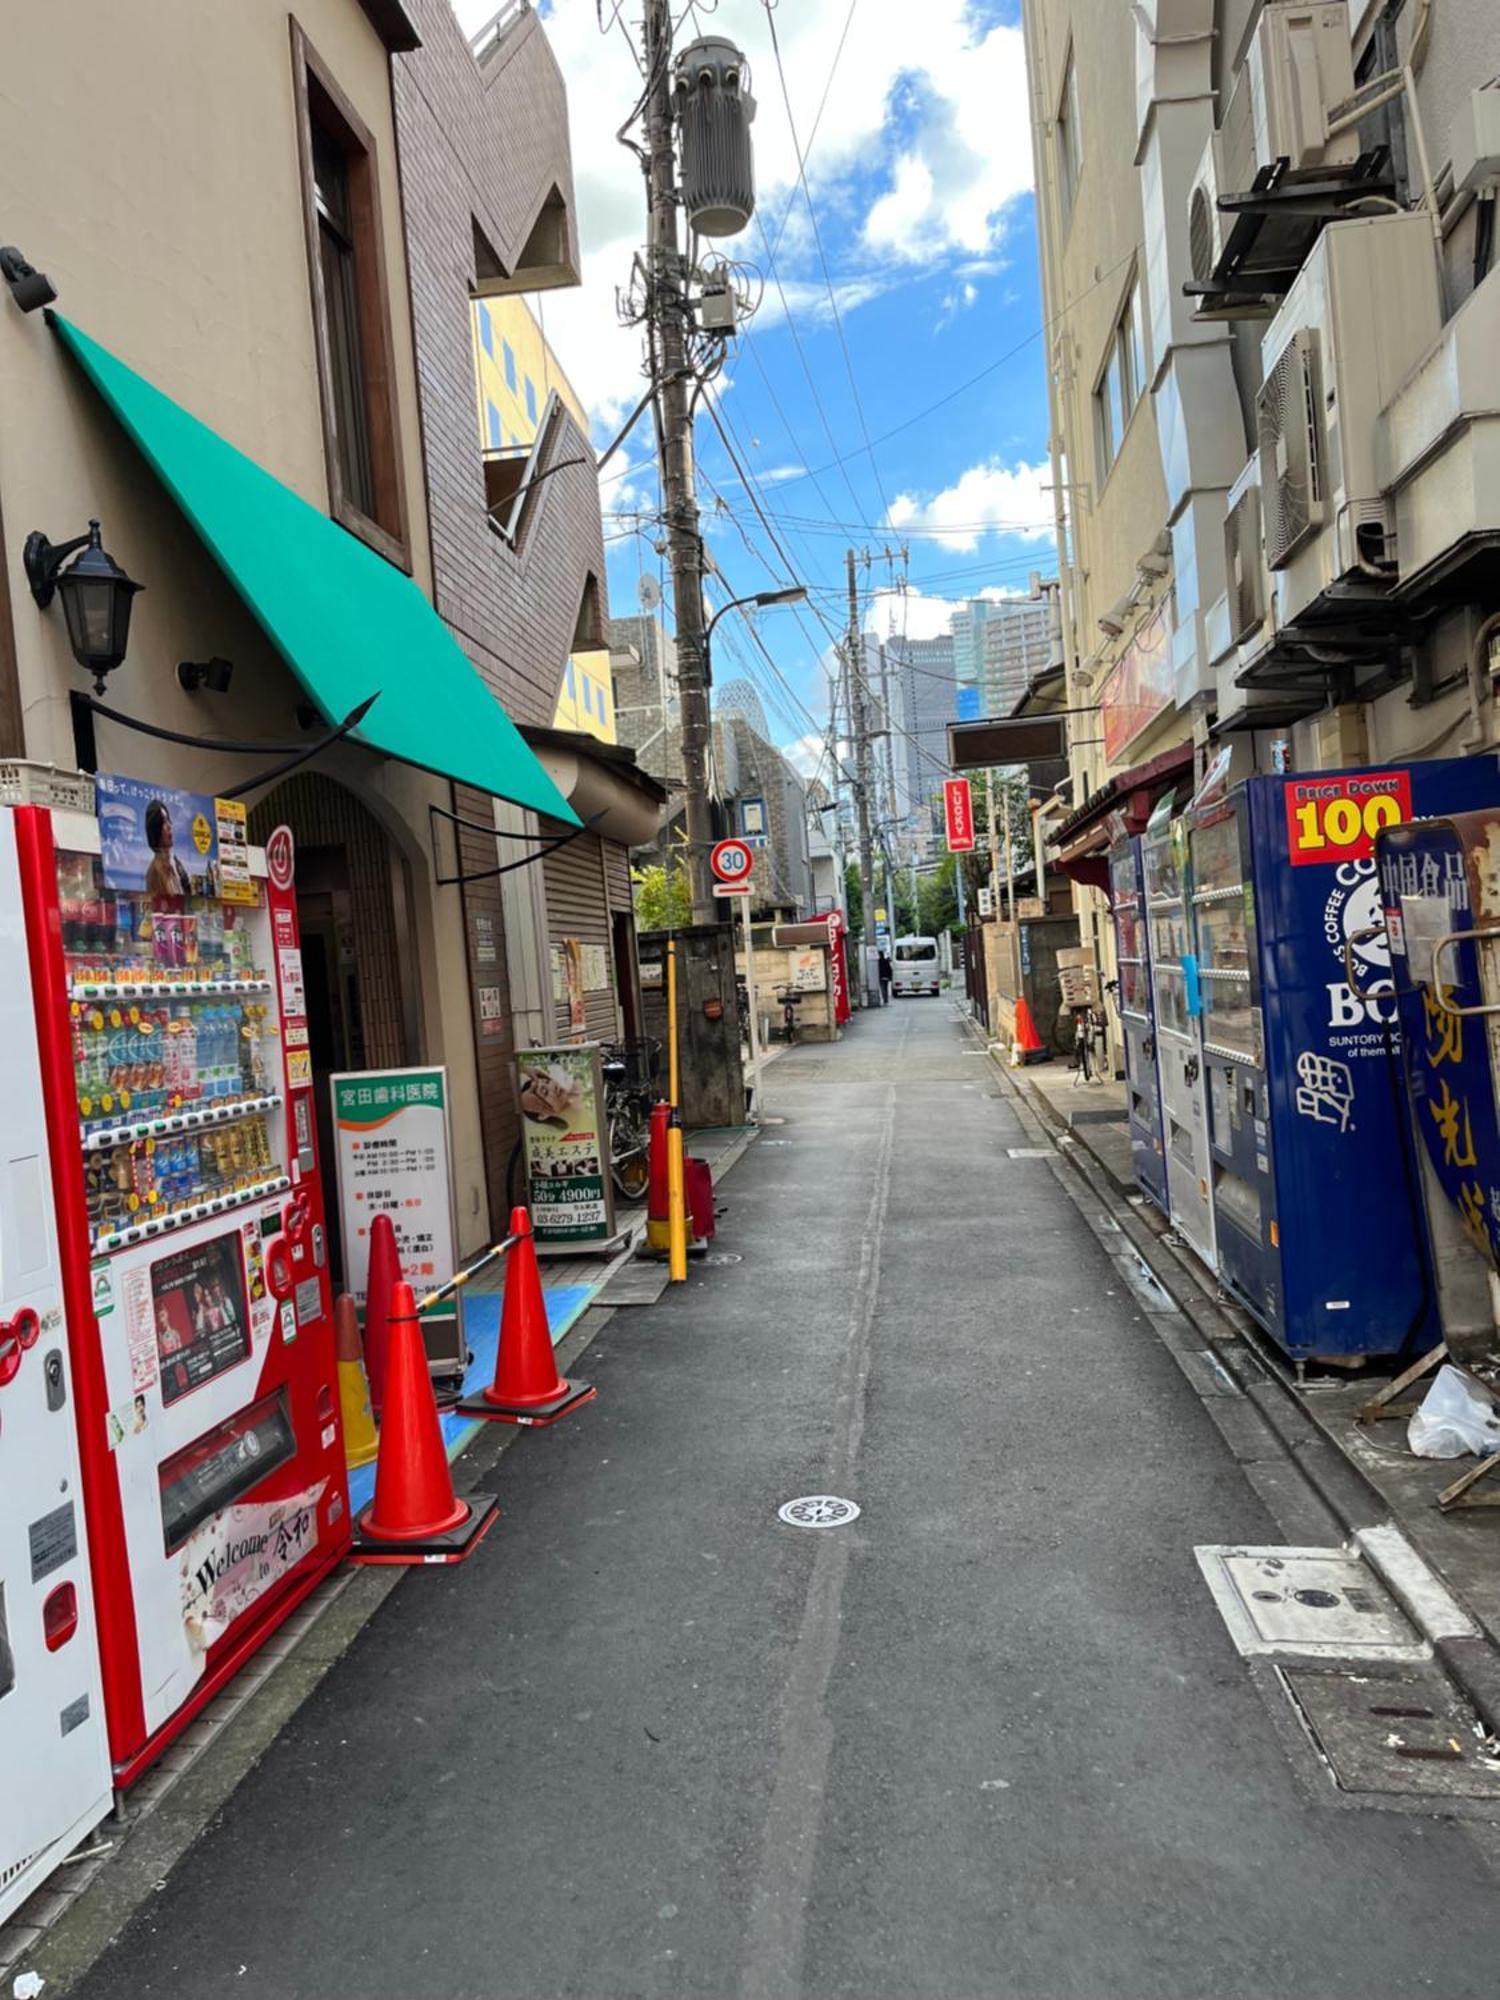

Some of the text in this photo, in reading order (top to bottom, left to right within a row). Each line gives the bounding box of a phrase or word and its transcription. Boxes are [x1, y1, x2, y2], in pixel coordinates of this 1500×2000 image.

[951, 784, 965, 836] LUCKY
[721, 851, 744, 870] 30
[1324, 888, 1345, 943] COFFEE
[1328, 1034, 1384, 1047] SUNTORY
[1348, 1047, 1358, 1058] of
[341, 1083, 439, 1106] 宮田歯科医院
[559, 1187, 601, 1202] 4900円
[195, 1507, 310, 1595] Welcome to 令和
